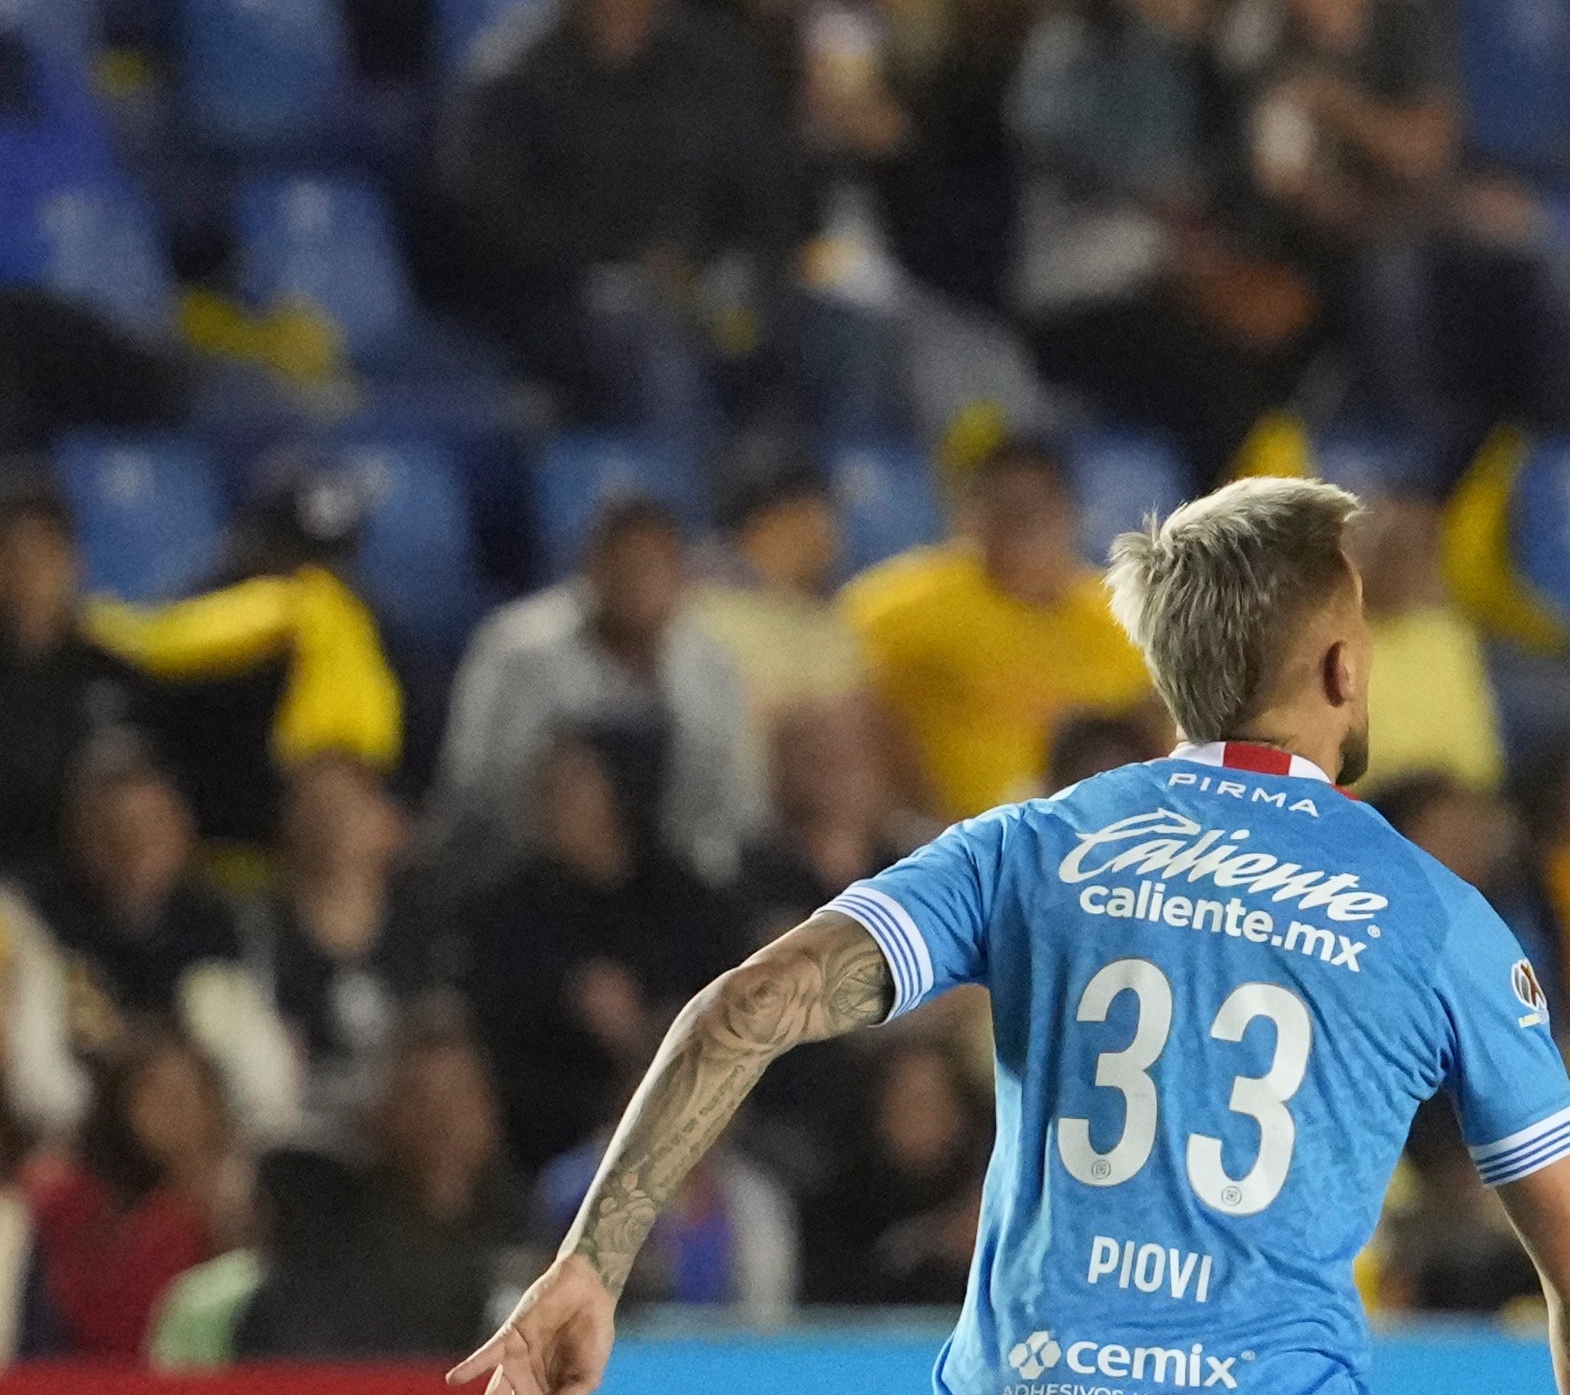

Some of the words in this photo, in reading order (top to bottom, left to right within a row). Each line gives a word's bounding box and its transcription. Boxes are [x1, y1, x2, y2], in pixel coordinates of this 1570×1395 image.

[1168, 772, 1320, 818] PIRMA
[1058, 807, 1389, 921] Caliente
[1079, 880, 1367, 973] caliente.mx
[1057, 957, 1313, 1217] 33
[1087, 1235, 1212, 1303] PIOVI
[1066, 1341, 1238, 1389] cemix
